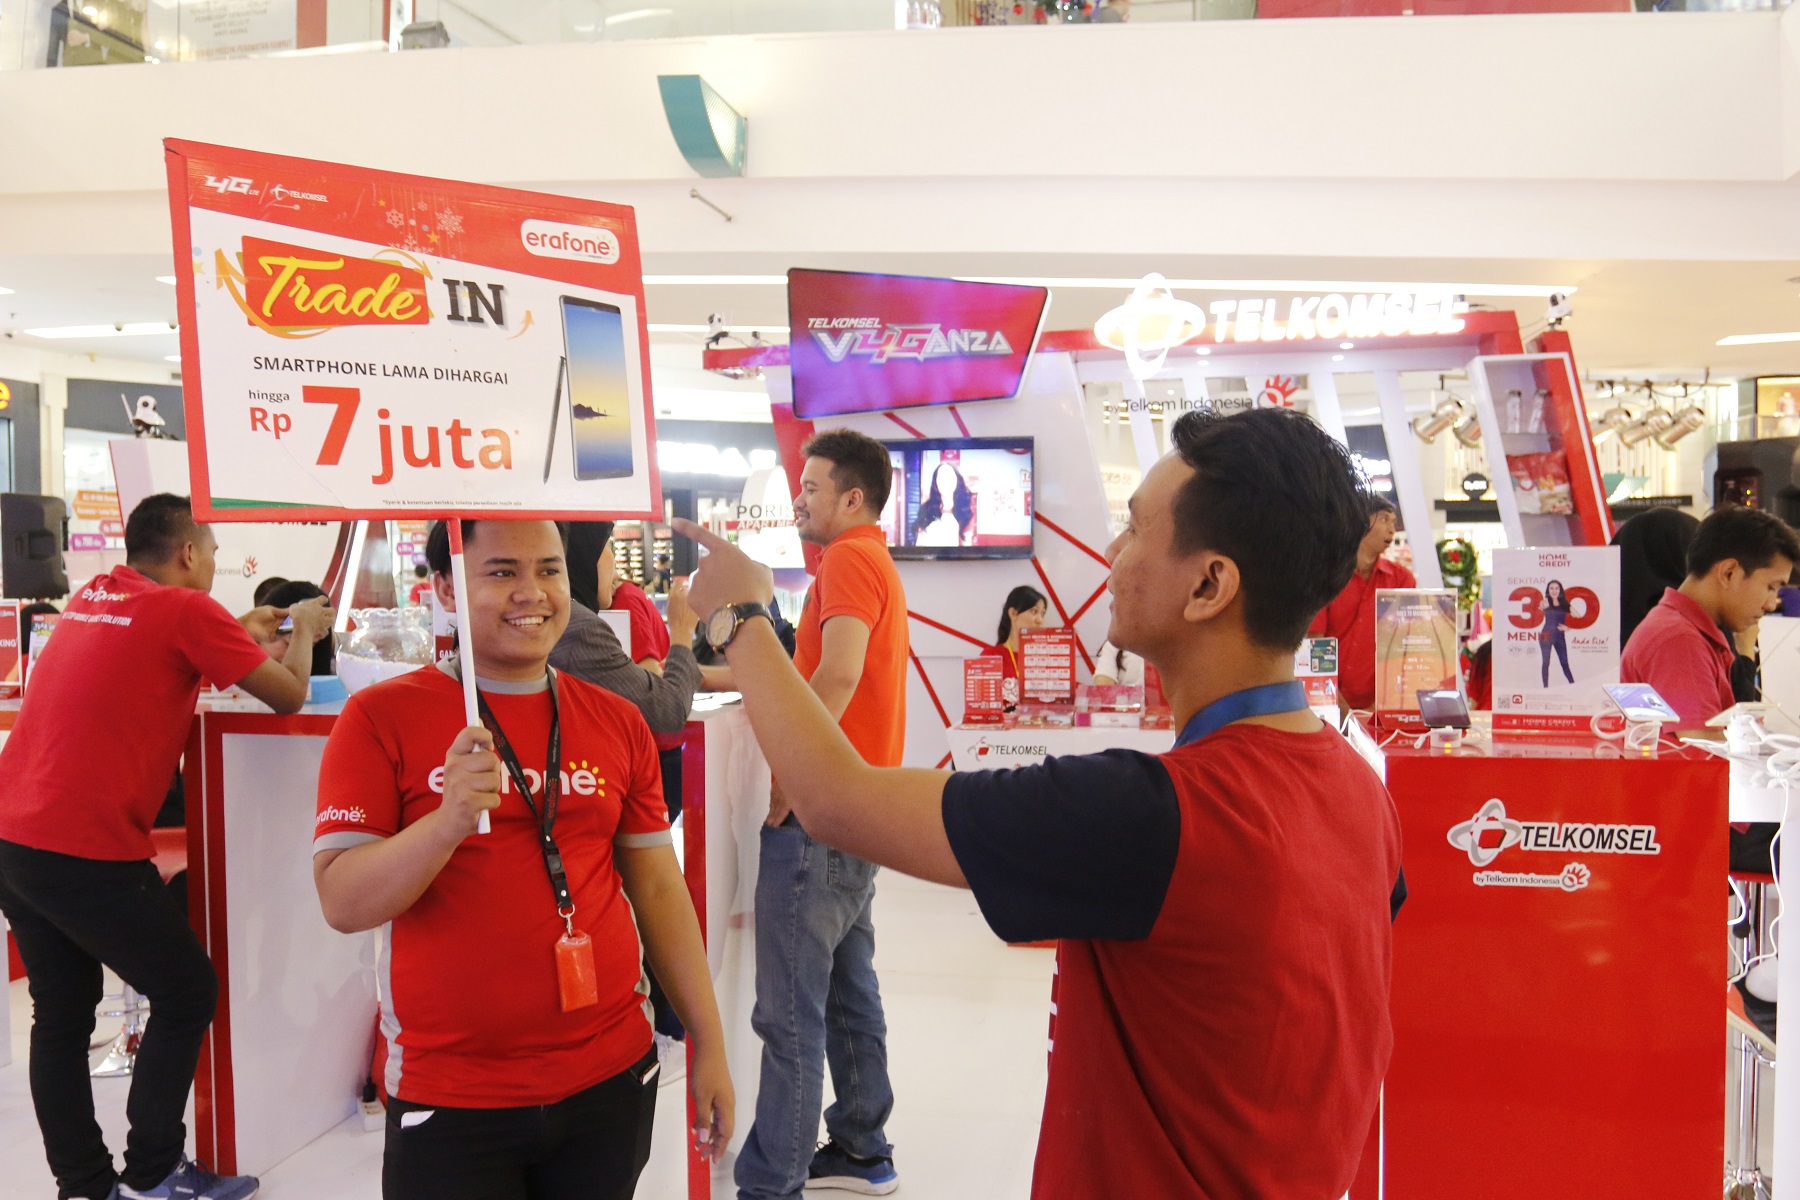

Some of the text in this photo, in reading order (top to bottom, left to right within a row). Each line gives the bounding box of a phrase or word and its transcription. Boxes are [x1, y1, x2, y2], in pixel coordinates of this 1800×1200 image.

[204, 175, 254, 195] 4G
[289, 190, 329, 203] TELKOMSEL
[526, 231, 610, 255] erafone
[258, 255, 505, 326] Trade IN
[807, 317, 883, 329] TELKOMSEL
[1209, 291, 1466, 343] TELKOMSEL
[253, 356, 509, 385] SMARTPHONE LAMA DIHARGAI
[248, 389, 290, 403] hingga
[1122, 398, 1177, 412] Telkom
[1180, 396, 1253, 410] Indonesia
[249, 406, 292, 439] Rp
[302, 385, 361, 466] 7
[737, 520, 796, 531] APARTME
[1507, 577, 1547, 585] SEKITAR
[1507, 586, 1600, 630] 30
[1507, 632, 1551, 641] MENIT
[995, 745, 1048, 756] TELKOMSEL
[428, 760, 598, 796] efone
[1521, 826, 1658, 851] TELKOMSEL
[1476, 874, 1560, 885] by Telkom Indonesia
